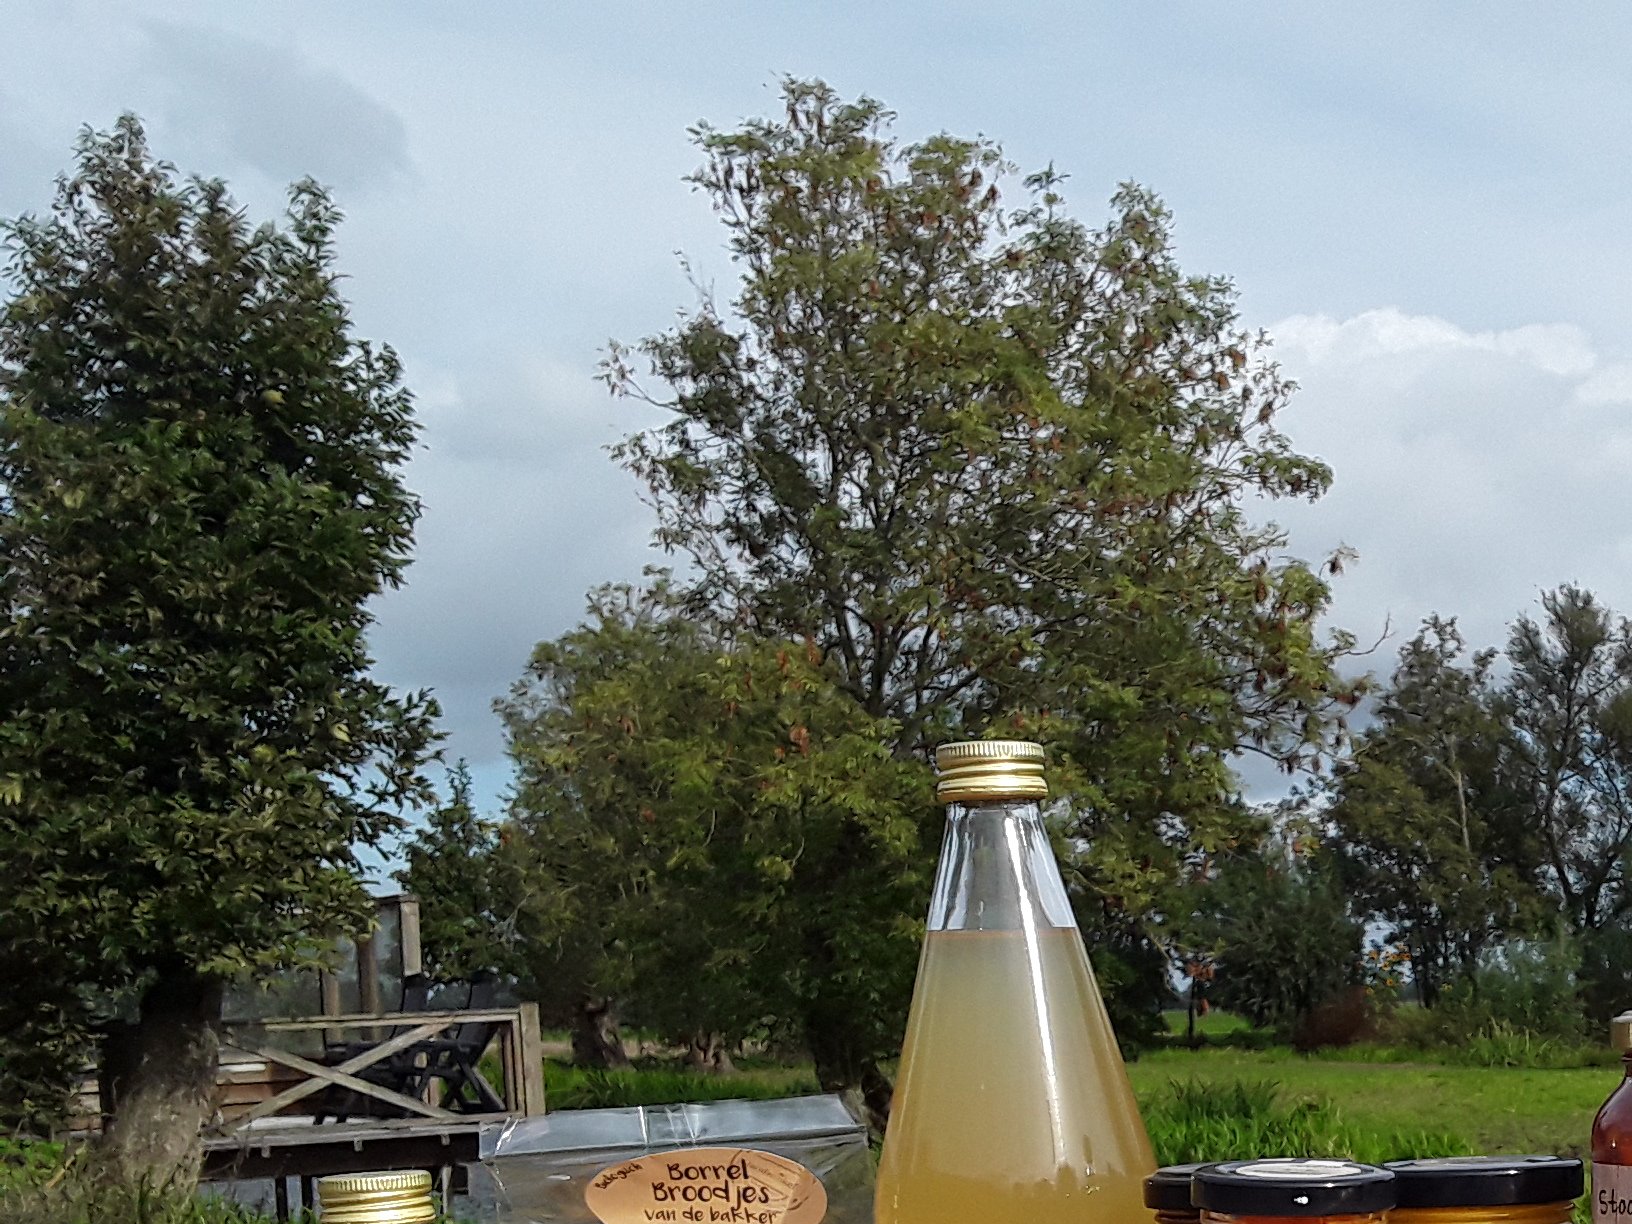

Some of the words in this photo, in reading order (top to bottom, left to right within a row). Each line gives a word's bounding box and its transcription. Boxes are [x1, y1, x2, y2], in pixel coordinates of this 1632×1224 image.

[667, 1158, 750, 1181] Borrel
[651, 1181, 769, 1212] Broodjes
[645, 1208, 677, 1222] van
[682, 1206, 703, 1222] de
[710, 1206, 777, 1224] bakker
